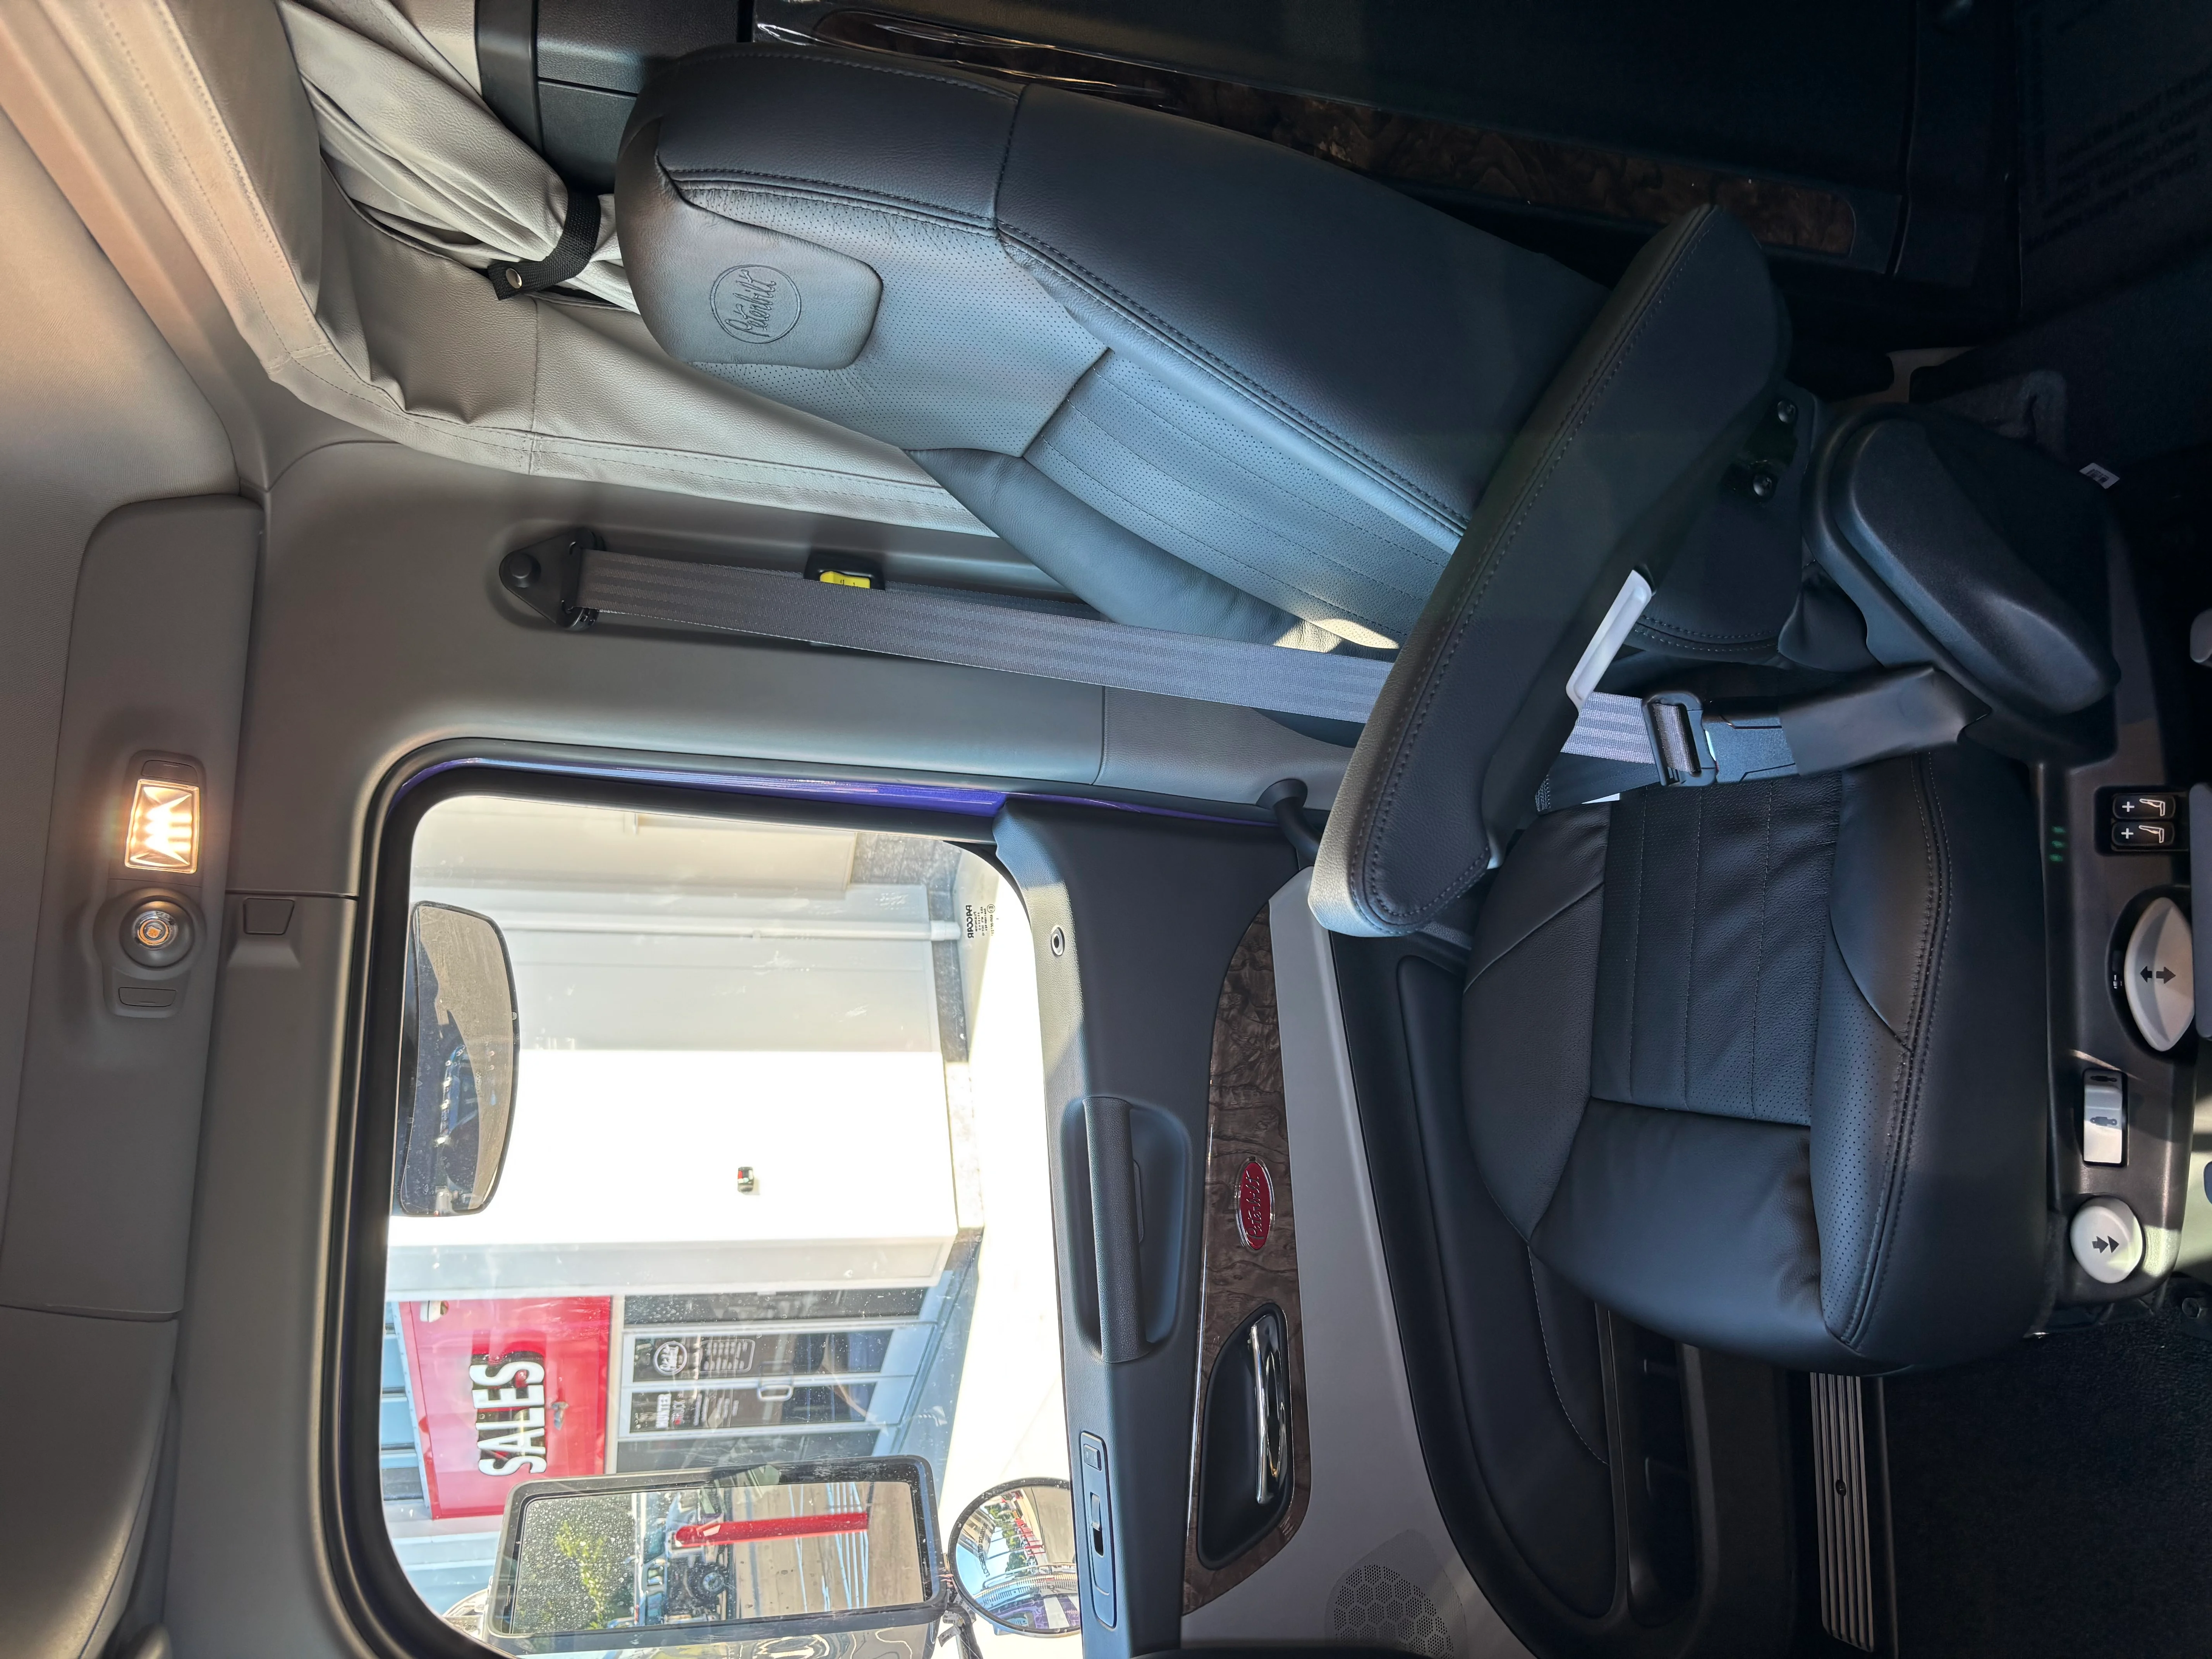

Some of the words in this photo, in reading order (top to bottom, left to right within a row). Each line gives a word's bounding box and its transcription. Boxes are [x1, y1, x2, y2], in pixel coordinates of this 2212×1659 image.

[725, 270, 776, 336] Peterbilt
[1245, 1170, 1264, 1239] Peterbilt
[469, 1360, 547, 1476] SALES
